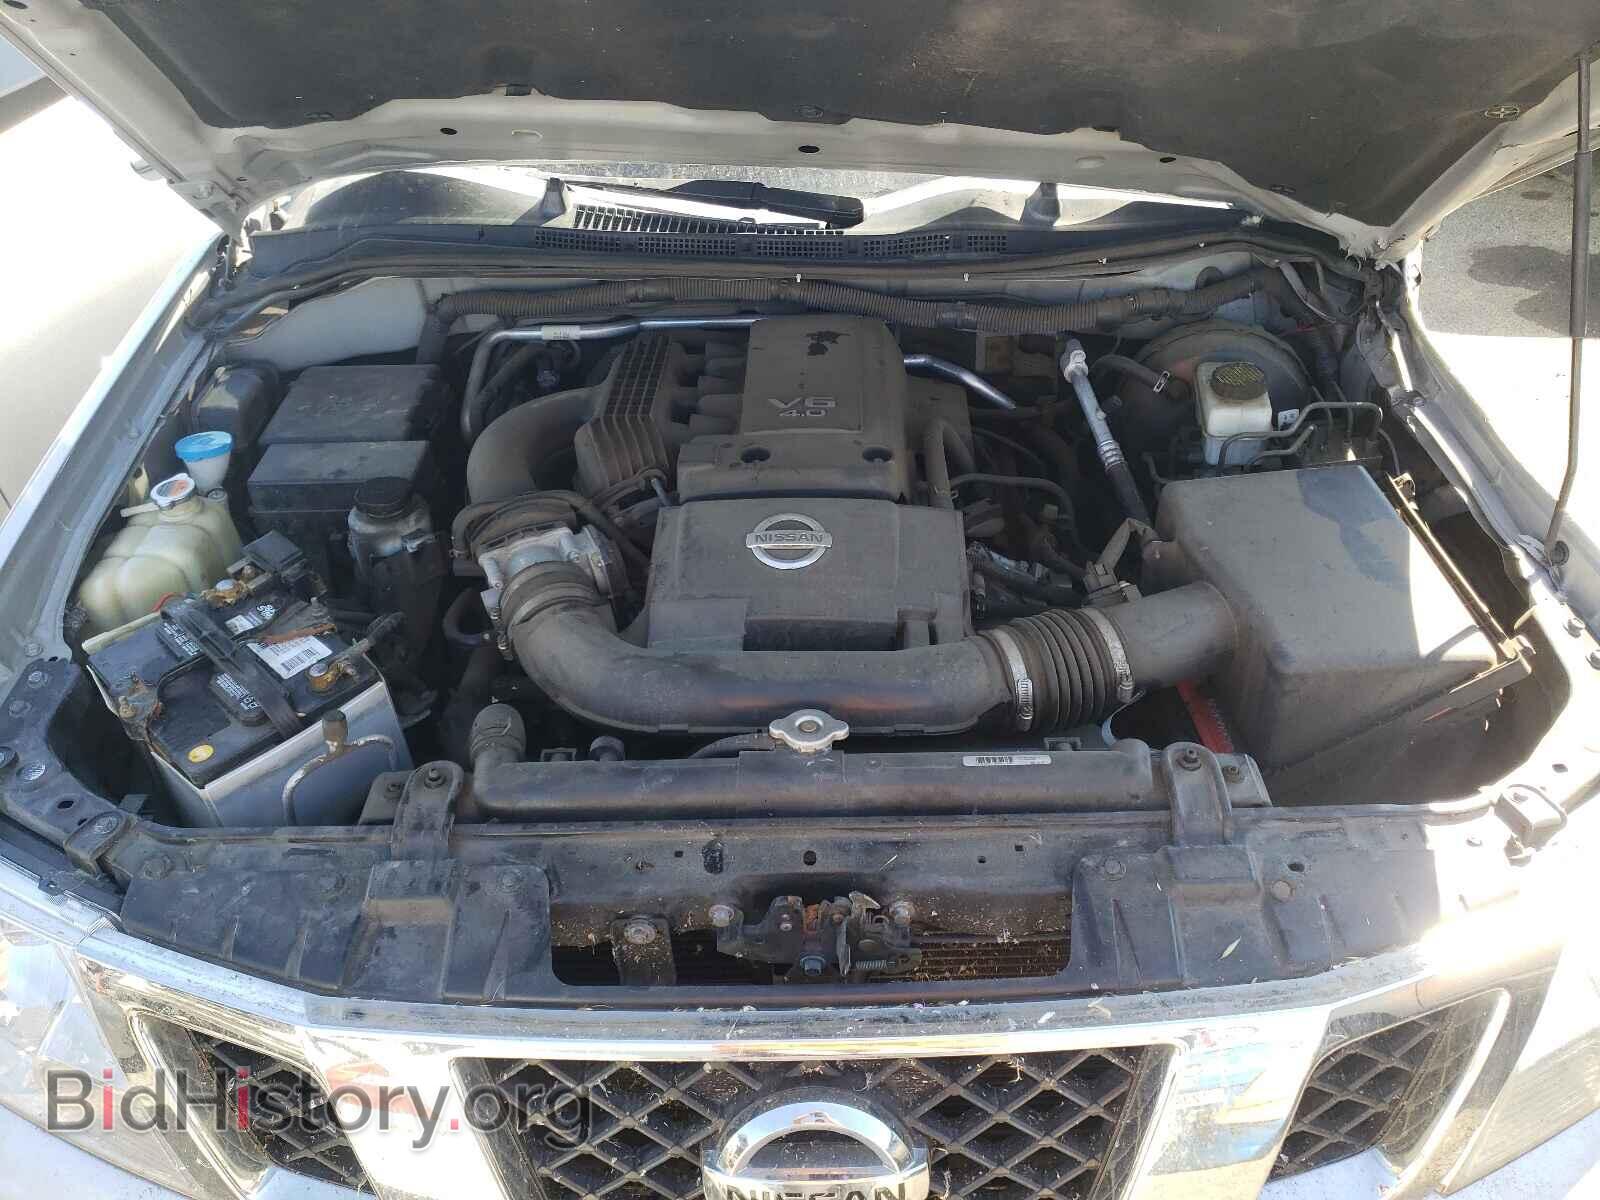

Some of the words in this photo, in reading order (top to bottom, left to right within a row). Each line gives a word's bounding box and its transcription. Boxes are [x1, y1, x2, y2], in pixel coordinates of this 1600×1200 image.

[767, 396, 836, 409] V6
[779, 408, 827, 417] 4.0
[754, 533, 824, 543] NISSAN
